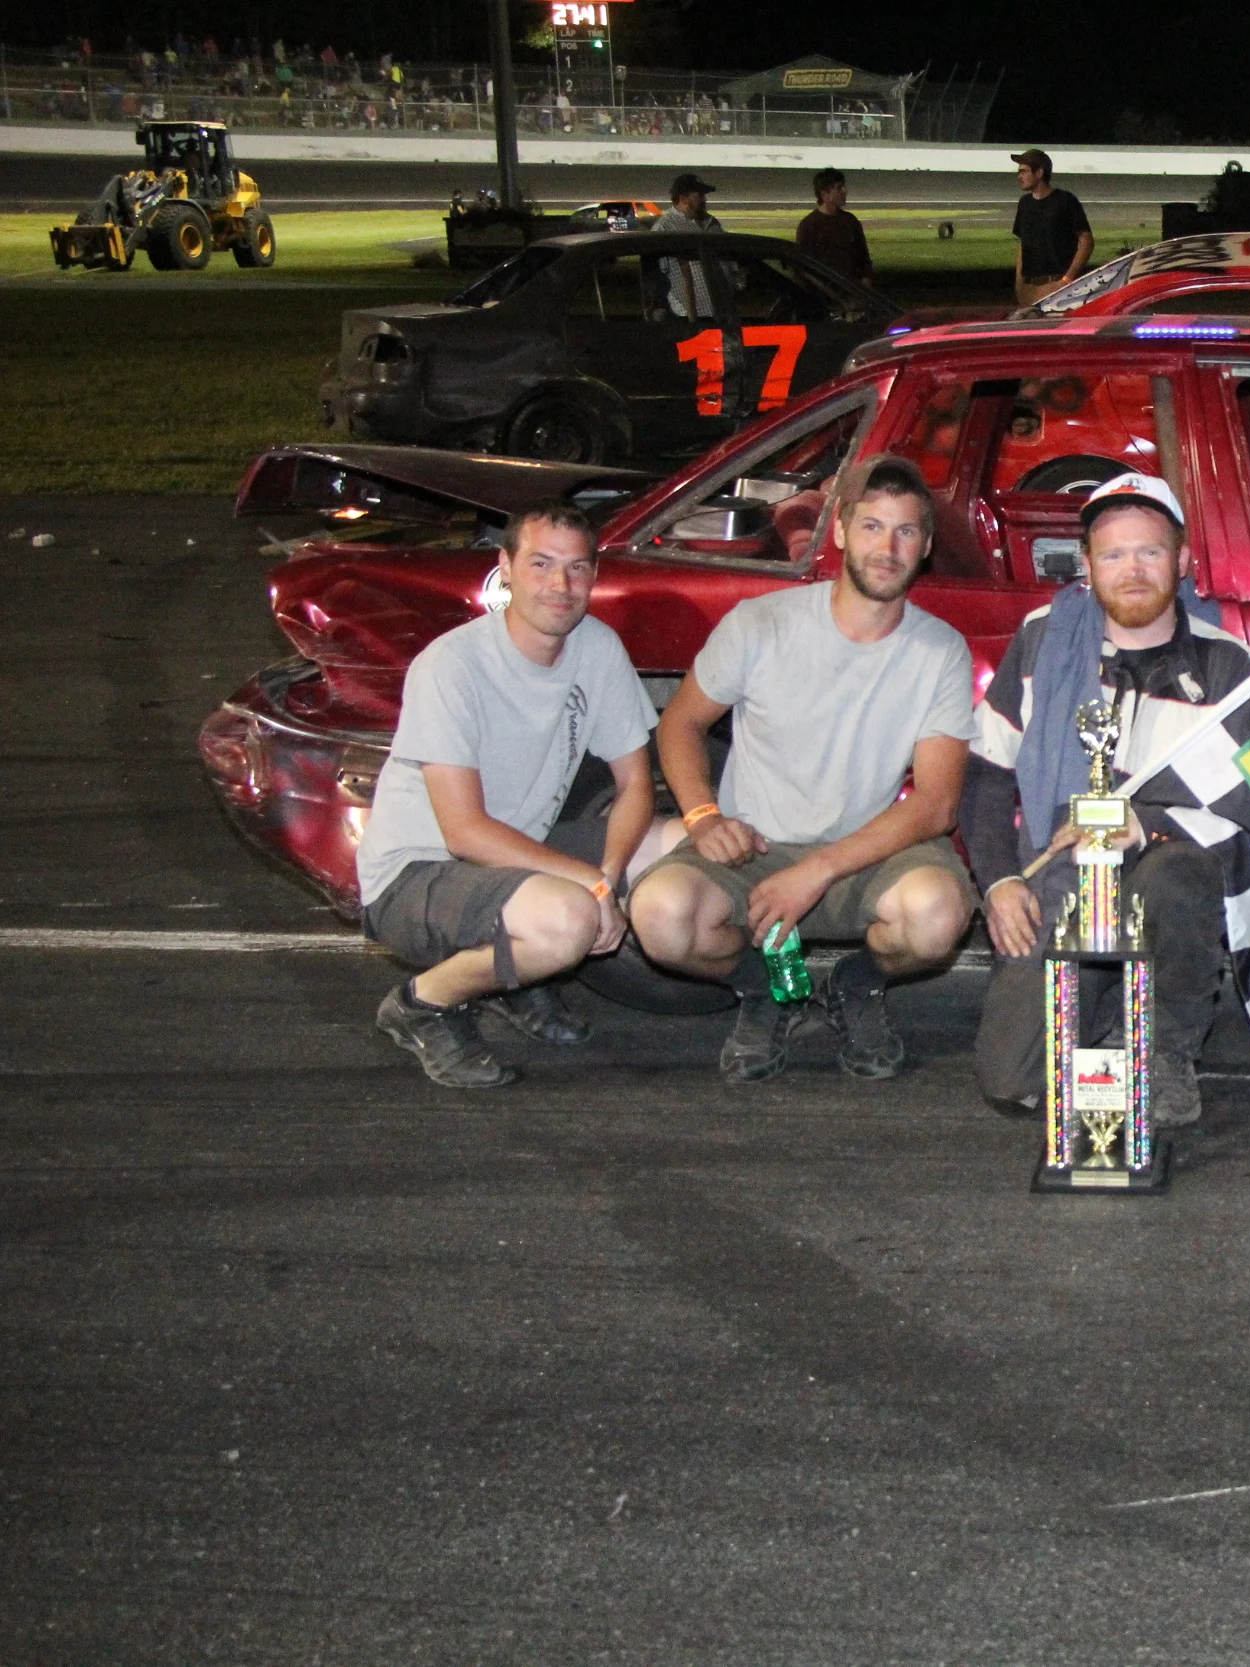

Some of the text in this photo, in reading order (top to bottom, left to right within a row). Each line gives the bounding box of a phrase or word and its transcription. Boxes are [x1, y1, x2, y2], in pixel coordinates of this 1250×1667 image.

[560, 29, 577, 37] LAP
[561, 42, 578, 50] POS
[565, 55, 571, 69] 1
[566, 79, 573, 92] 2
[676, 325, 807, 416] 17
